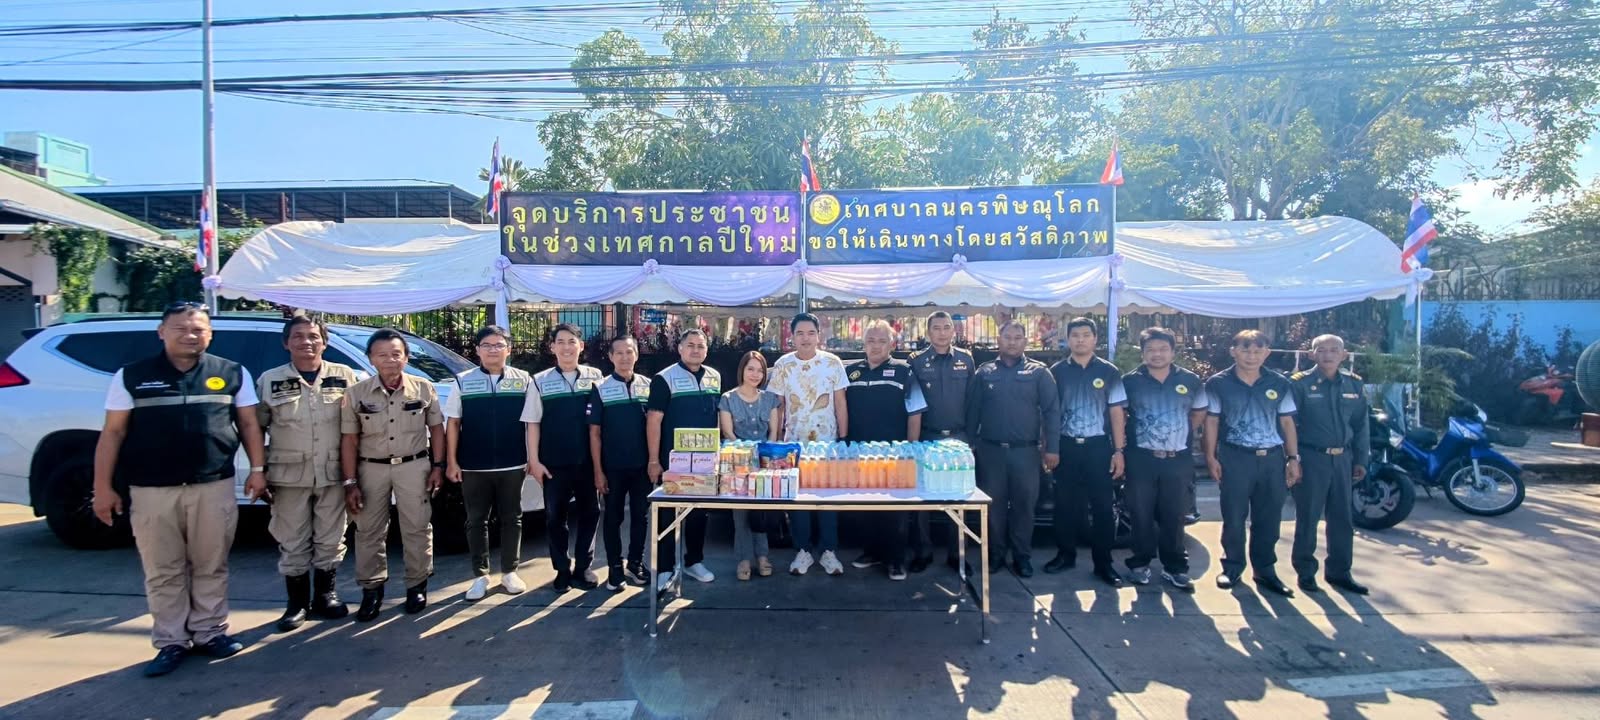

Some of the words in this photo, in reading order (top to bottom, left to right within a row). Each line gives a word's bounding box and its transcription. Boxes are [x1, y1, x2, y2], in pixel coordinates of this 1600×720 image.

[511, 198, 791, 232] จุดบริการประชาชน
[844, 191, 1100, 221] เทศบาลนครพิษณุโลก
[503, 225, 797, 253] ในช่วงเทศกาลปีใหม่
[808, 225, 1108, 250] ขอให้เดินทางโดยสวัสดิภาพ
